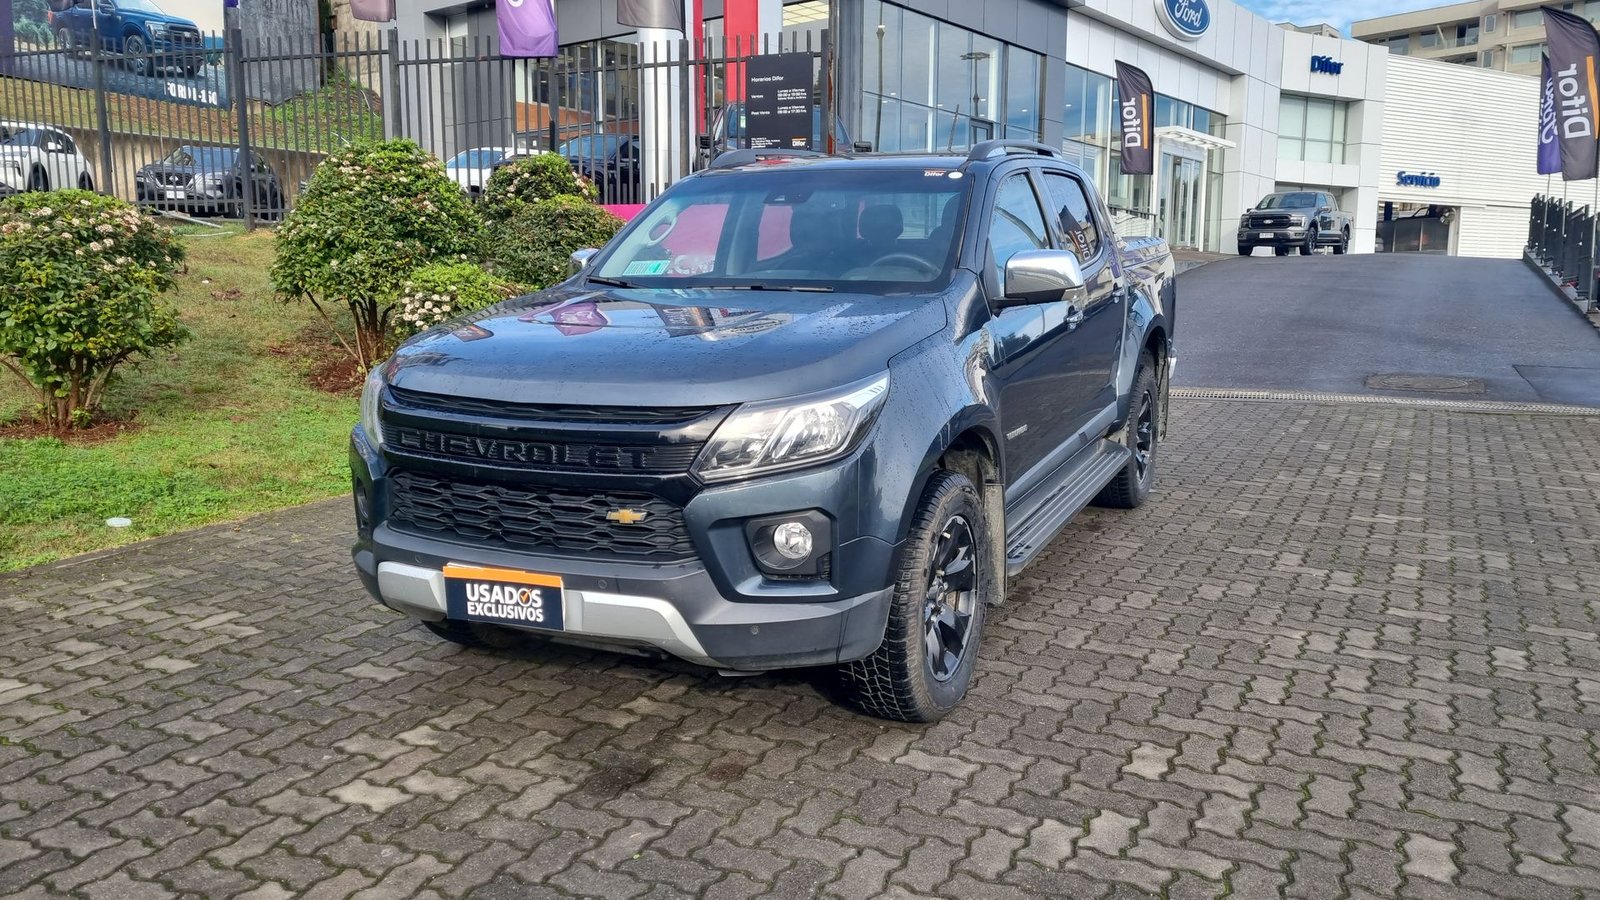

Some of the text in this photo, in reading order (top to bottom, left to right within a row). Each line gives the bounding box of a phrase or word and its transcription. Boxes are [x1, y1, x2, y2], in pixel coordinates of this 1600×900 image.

[1174, 0, 1203, 27] Ford
[1310, 55, 1344, 75] Difor
[1396, 171, 1440, 188] Servicio
[401, 429, 656, 468] CHEVROLET
[466, 583, 543, 607] USADOS
[467, 602, 544, 622] EXCLUSIVOS
